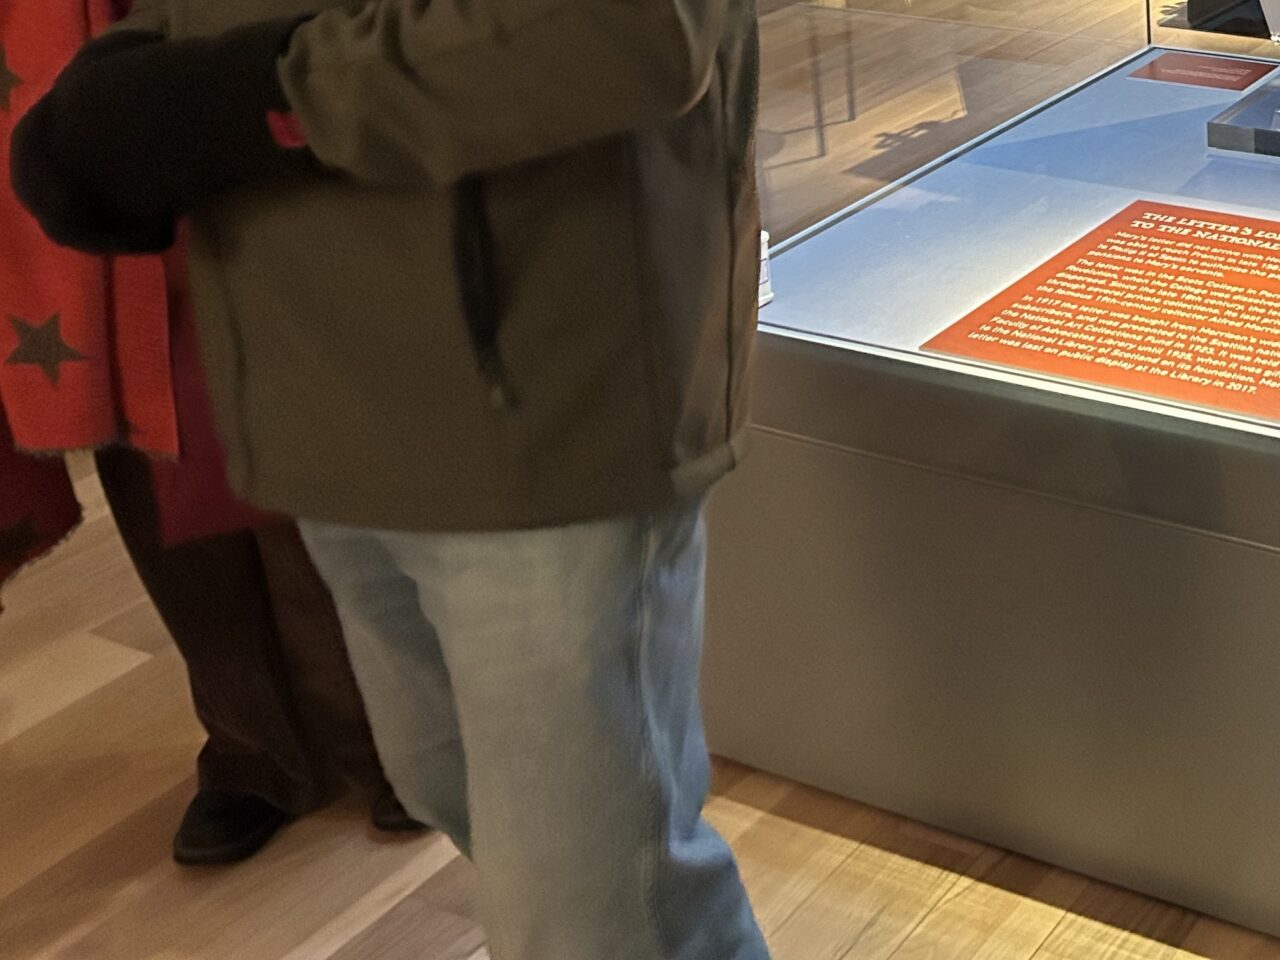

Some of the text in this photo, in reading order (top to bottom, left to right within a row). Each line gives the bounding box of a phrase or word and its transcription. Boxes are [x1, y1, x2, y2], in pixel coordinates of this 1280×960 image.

[1142, 212, 1176, 222] THE
[1130, 220, 1155, 229] TO
[1157, 225, 1192, 235] THE
[1192, 231, 1280, 250] NATIONAL
